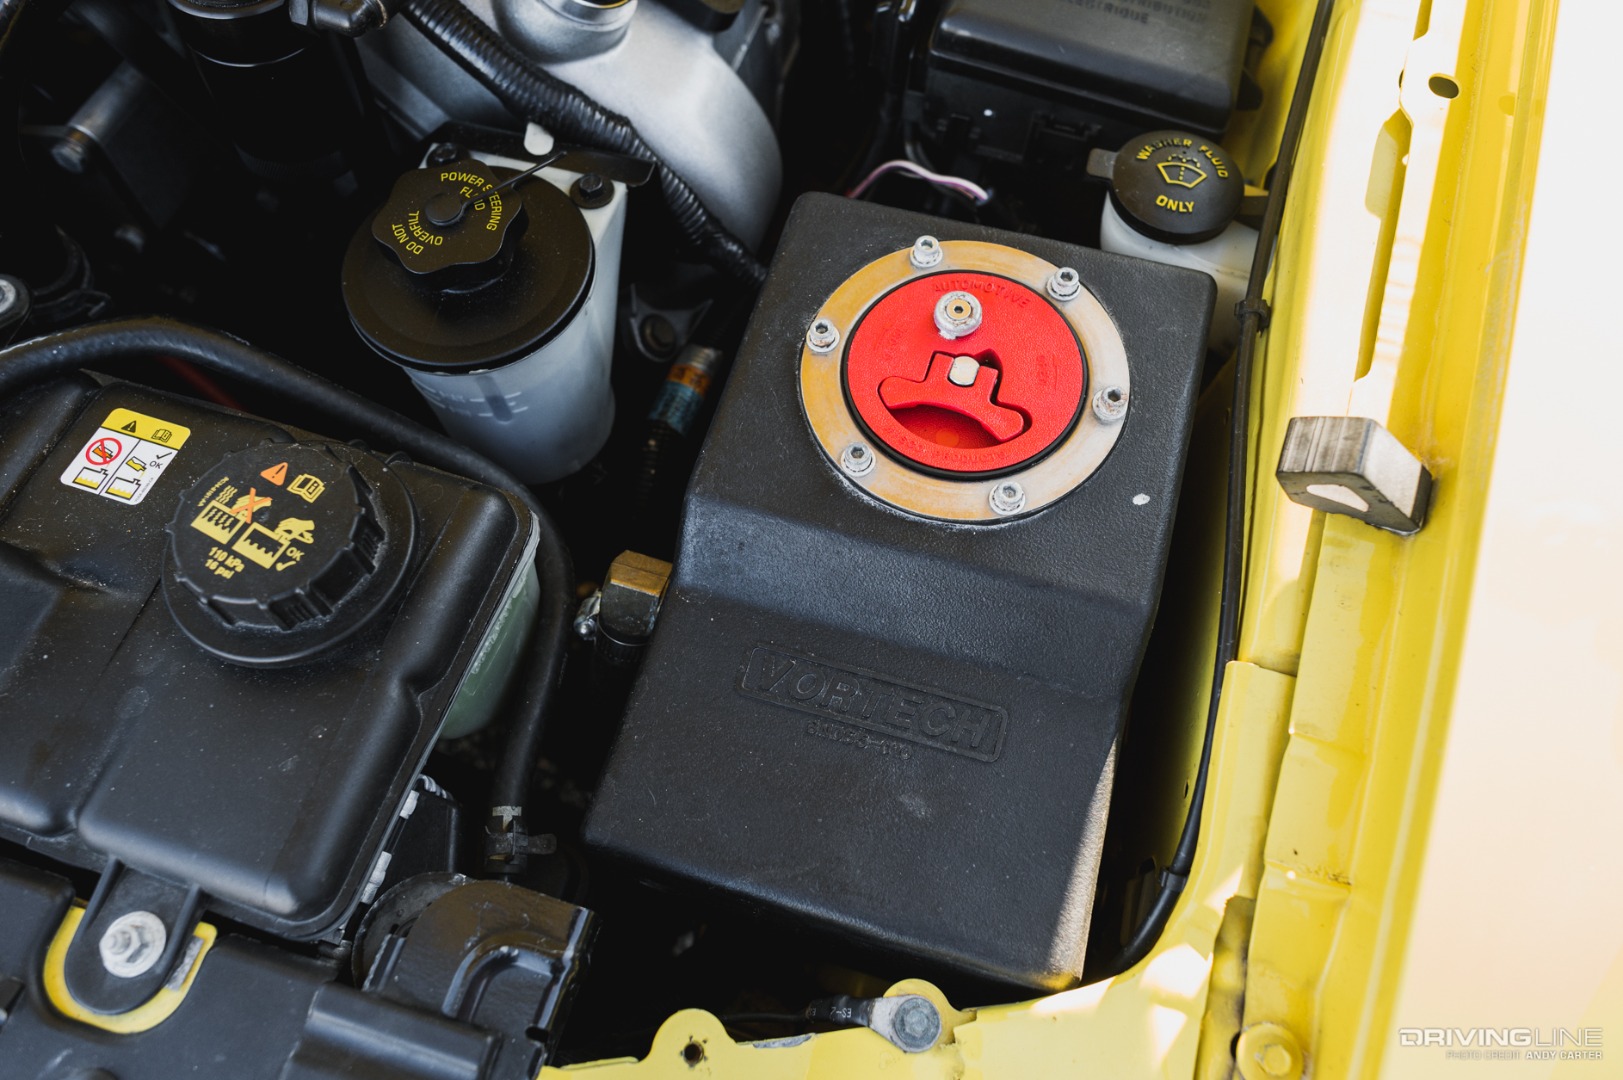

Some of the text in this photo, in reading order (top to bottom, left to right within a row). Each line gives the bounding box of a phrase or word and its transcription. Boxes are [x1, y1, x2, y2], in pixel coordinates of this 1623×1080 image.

[1136, 138, 1228, 178] WASHER FLUID
[440, 171, 484, 187] POWER
[1156, 195, 1194, 213] ONLY
[408, 210, 443, 246] OVERFILL
[391, 223, 424, 255] DO NOT
[934, 279, 1030, 308] AUTOMOTIVE
[149, 461, 163, 469] OK
[208, 547, 228, 561] 110
[286, 547, 305, 561] OK
[205, 559, 219, 570] 16
[755, 654, 992, 748] VORTECH
